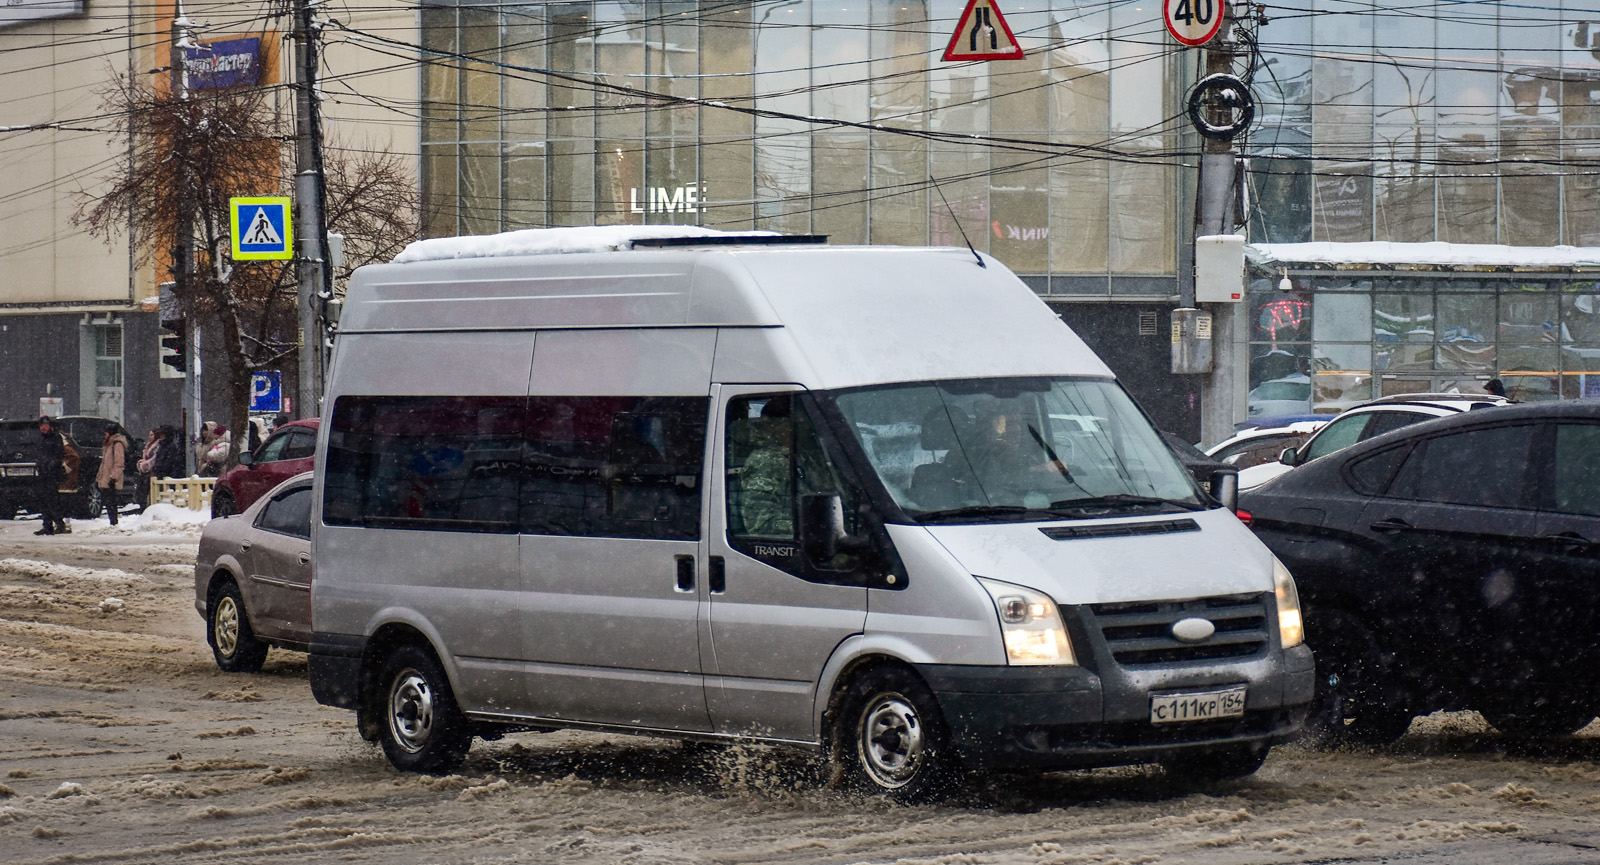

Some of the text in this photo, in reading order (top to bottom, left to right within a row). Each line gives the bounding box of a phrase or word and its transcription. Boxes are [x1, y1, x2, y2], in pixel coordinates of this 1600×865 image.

[1174, 0, 1213, 26] 40
[250, 374, 272, 407] P
[754, 545, 795, 557] TRANSIT
[1220, 693, 1243, 710] 154
